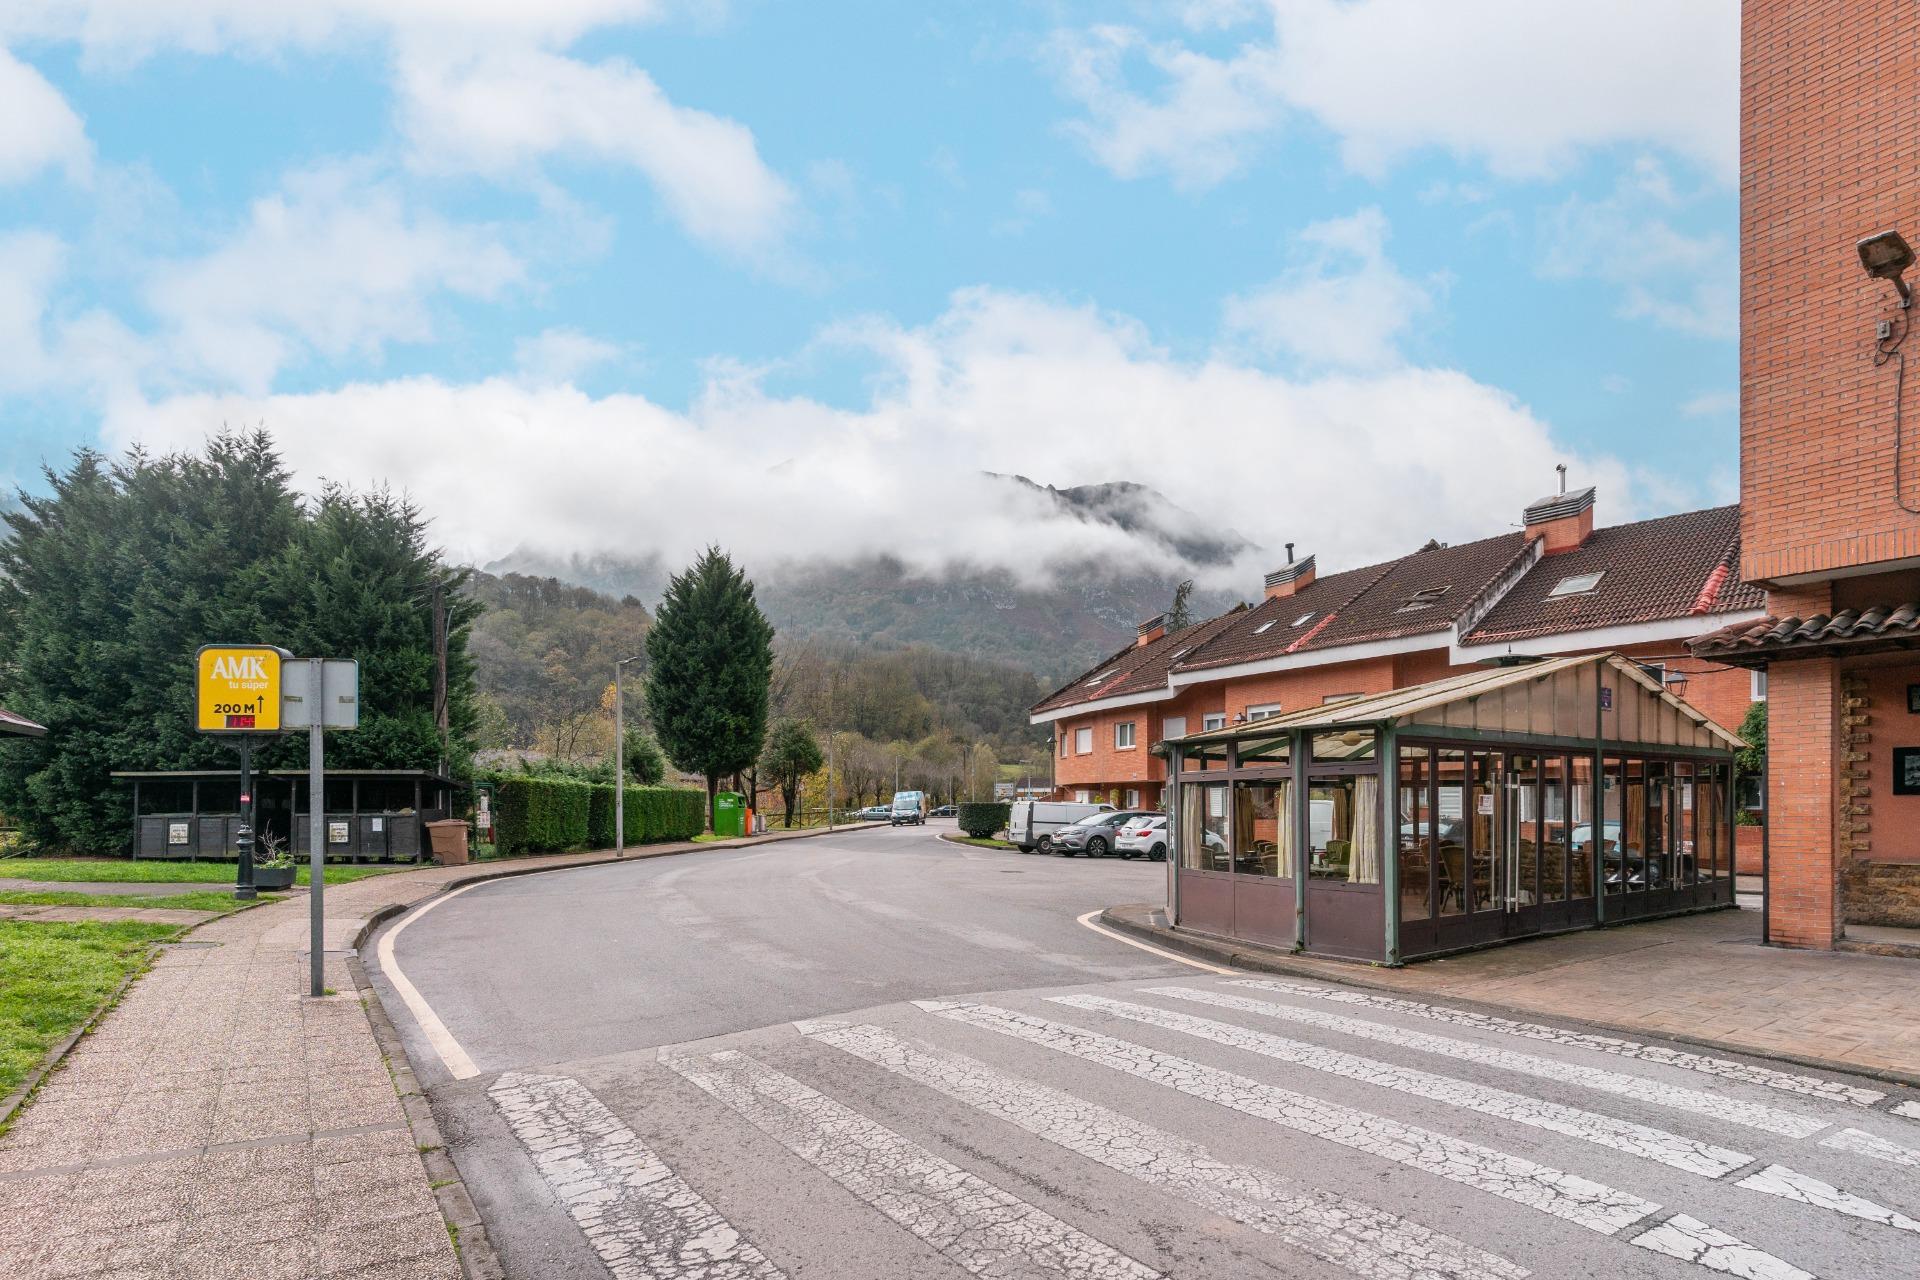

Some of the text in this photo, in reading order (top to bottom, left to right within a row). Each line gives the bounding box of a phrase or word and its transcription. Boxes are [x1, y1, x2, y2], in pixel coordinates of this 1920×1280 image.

[210, 656, 269, 679] AMK
[229, 680, 239, 689] tu
[214, 703, 255, 713] 200 M
